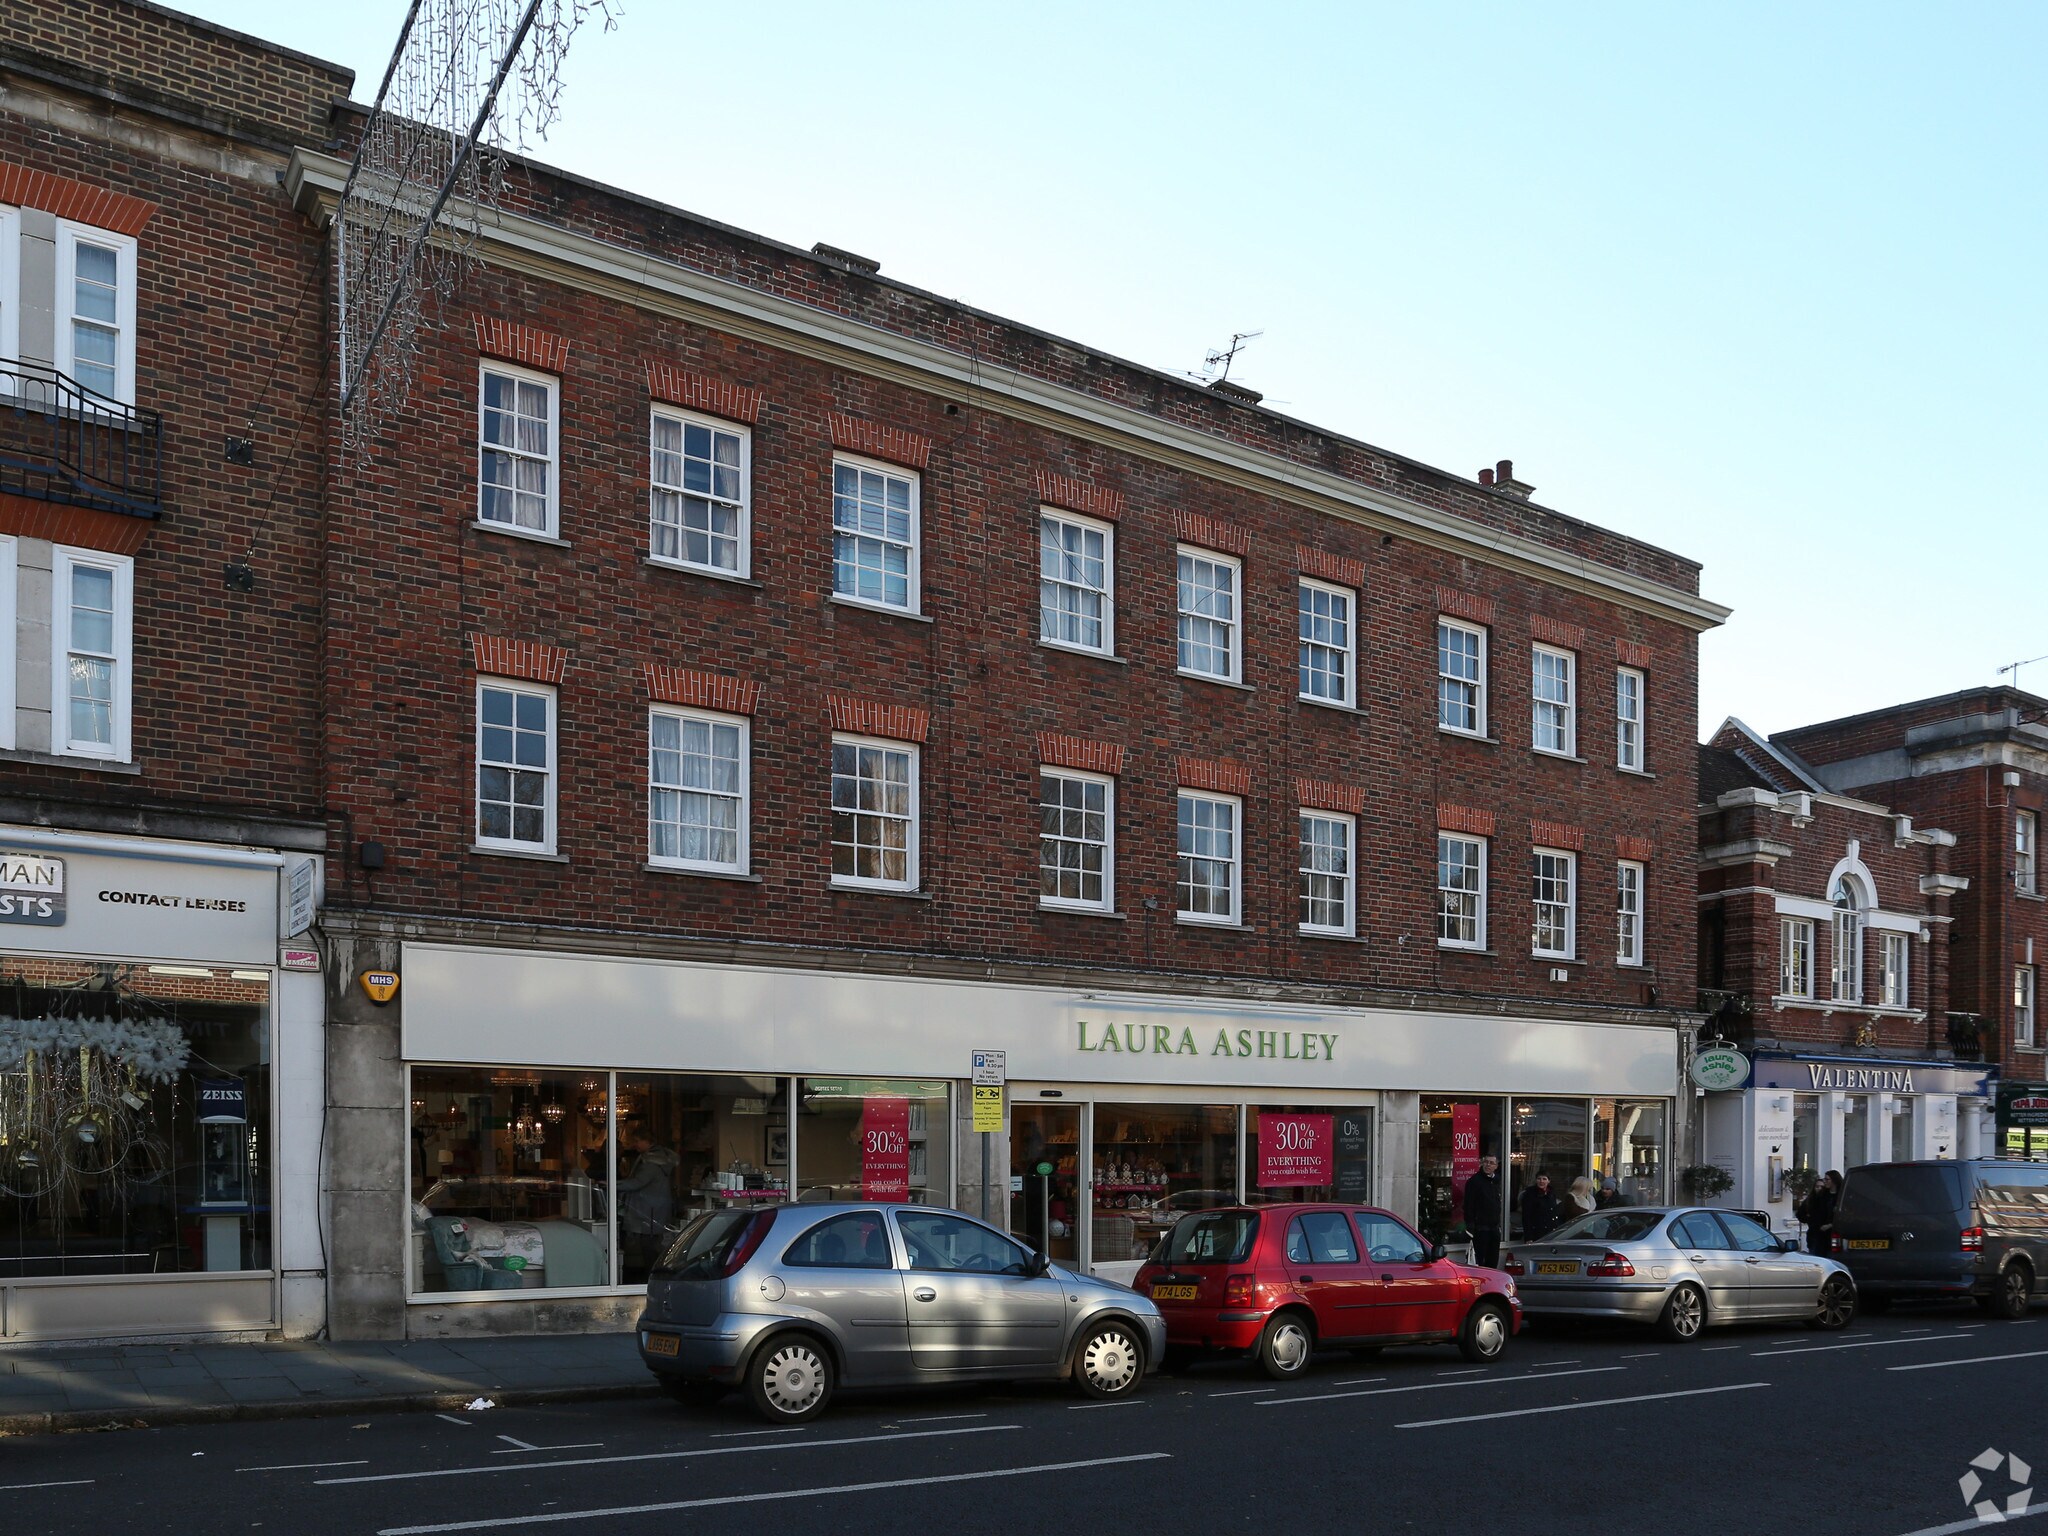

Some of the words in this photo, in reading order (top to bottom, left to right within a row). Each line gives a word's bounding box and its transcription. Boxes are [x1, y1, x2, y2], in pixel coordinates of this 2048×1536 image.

[98, 890, 182, 908] CONTACT
[185, 897, 246, 913] LENSES
[370, 975, 393, 985] MHS
[1077, 1021, 1199, 1055] LAURA
[1211, 1027, 1339, 1061] ASHLEY
[1704, 1054, 1734, 1063] laura
[1701, 1061, 1737, 1074] ashley
[1807, 1063, 1915, 1093] VALENTINA
[202, 1089, 243, 1100] ZEISS
[1343, 1120, 1360, 1136] 0%
[866, 1130, 904, 1154] 30%
[1276, 1122, 1315, 1150] 30%
[1454, 1132, 1477, 1150] 30%
[1267, 1156, 1322, 1166] EVERYTHING
[1267, 1168, 1279, 1177] you
[1279, 1167, 1295, 1175] could
[1295, 1167, 1309, 1175] wish
[1157, 1286, 1173, 1297] V74
[1173, 1286, 1193, 1297] LGS
